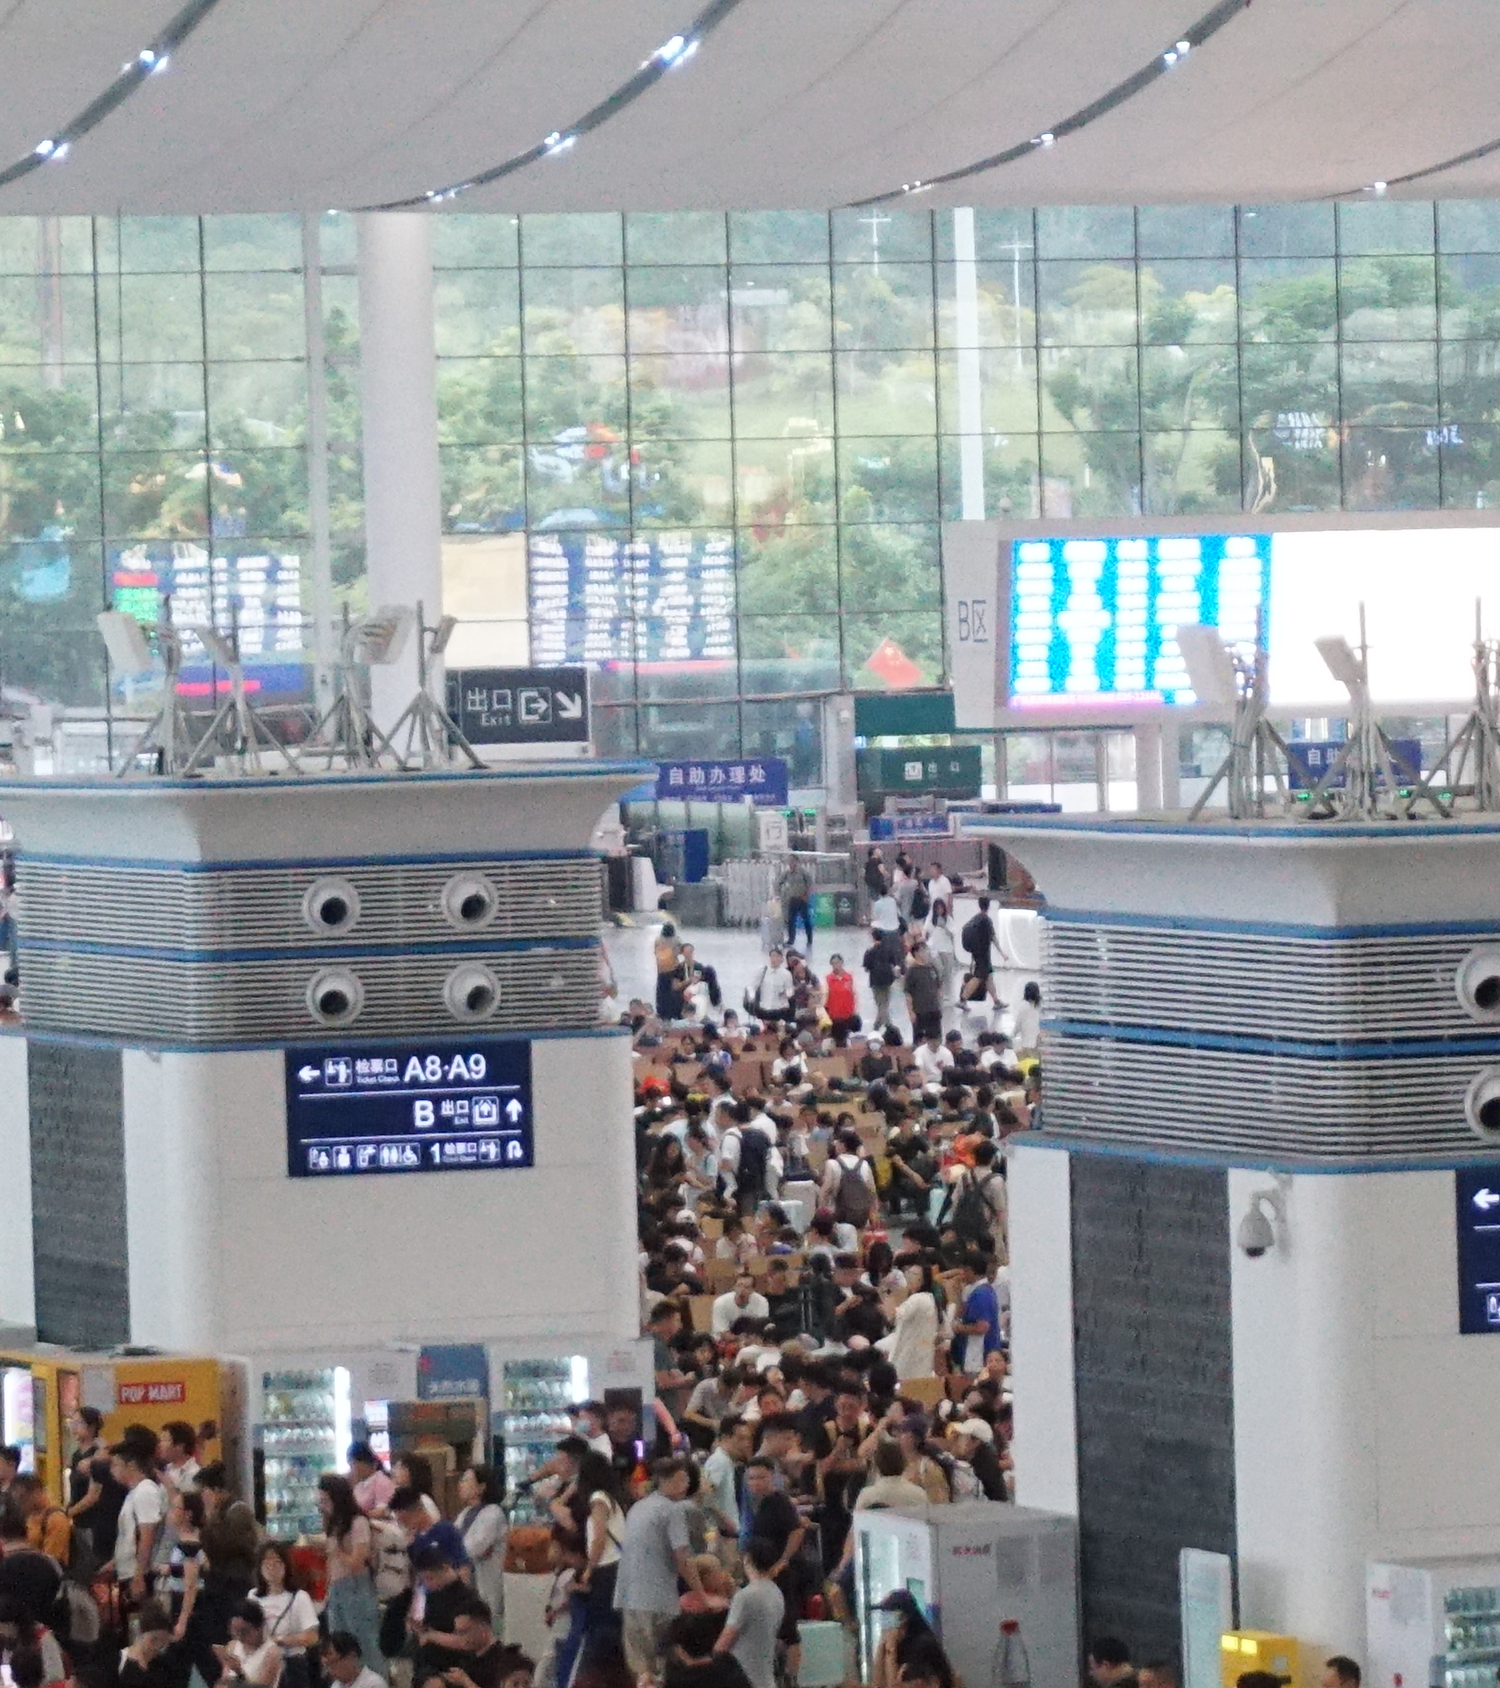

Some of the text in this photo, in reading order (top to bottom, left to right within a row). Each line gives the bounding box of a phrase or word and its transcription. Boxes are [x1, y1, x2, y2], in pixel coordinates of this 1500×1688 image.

[958, 600, 988, 642] B区
[467, 687, 512, 712] 出口
[481, 713, 511, 727] Exit
[669, 765, 767, 787] 自助办理处
[355, 1053, 487, 1082] 检票口 A8·A9
[414, 1099, 469, 1127] B 出口
[430, 1142, 440, 1163] 1
